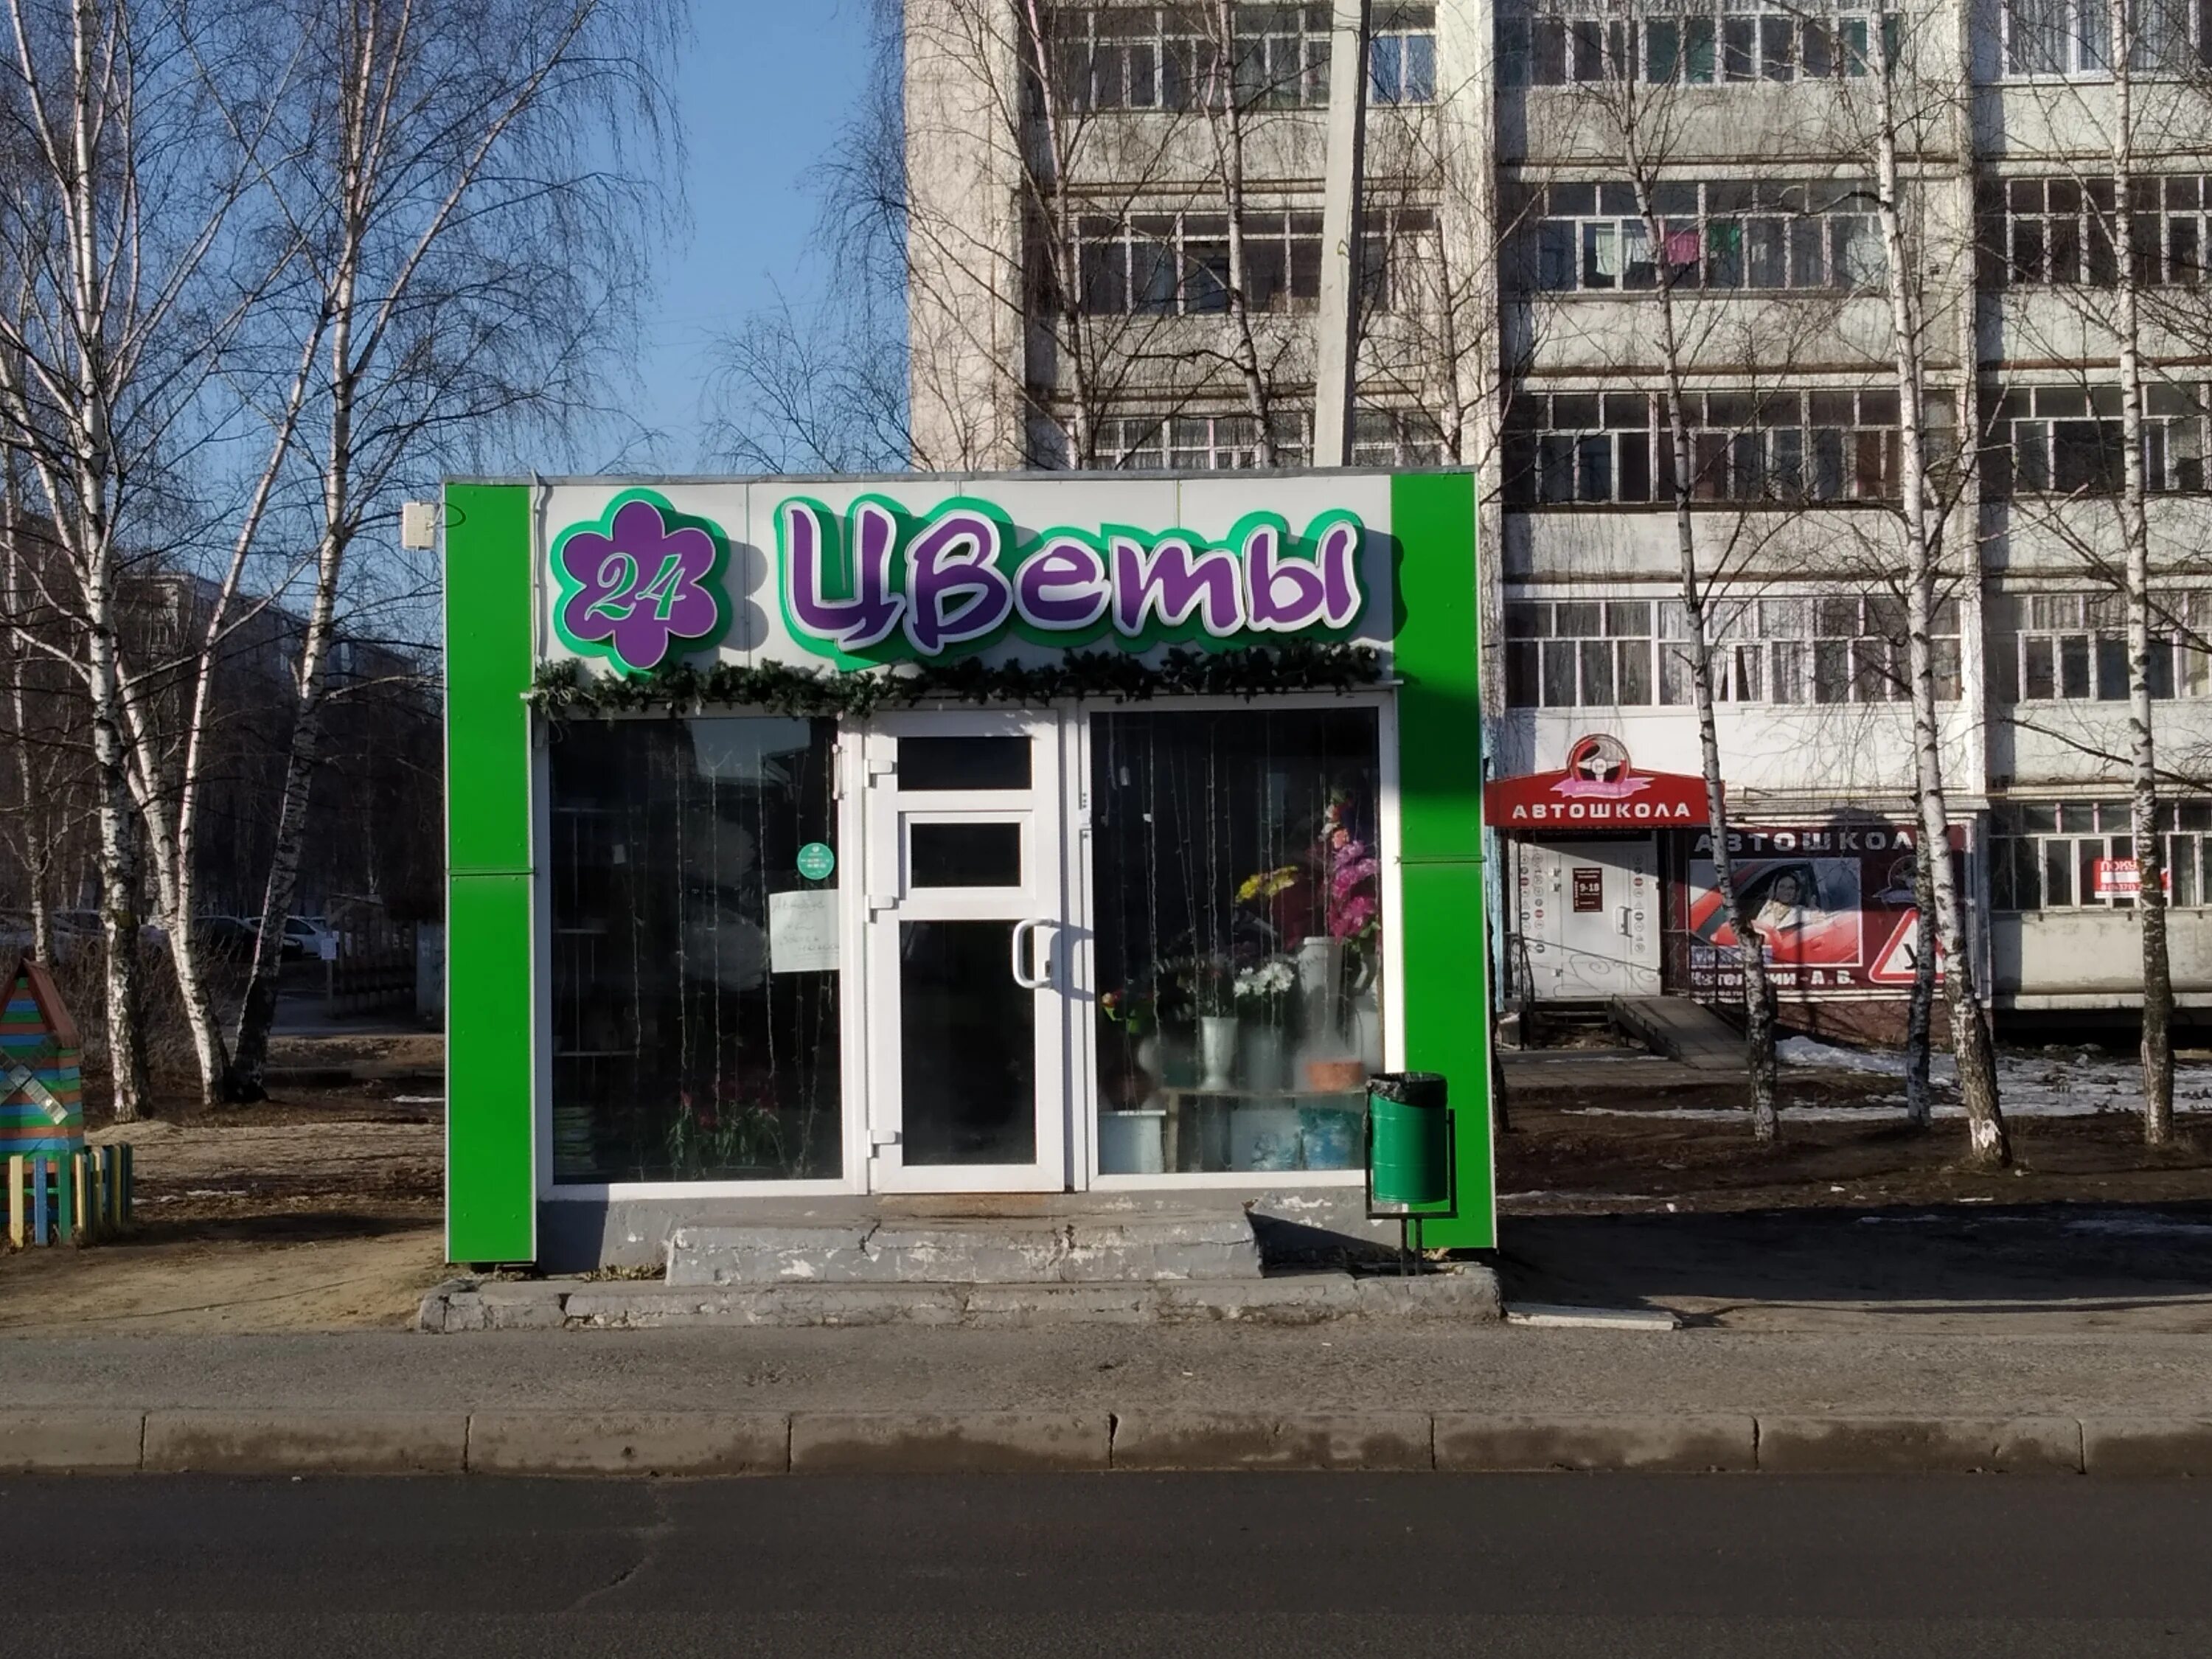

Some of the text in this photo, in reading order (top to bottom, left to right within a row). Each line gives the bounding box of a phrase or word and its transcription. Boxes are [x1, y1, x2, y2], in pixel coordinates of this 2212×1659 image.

[584, 552, 686, 621] 24
[1512, 803, 1691, 819] АВТОШКОЛА
[1694, 830, 1913, 852] АВТОШКОЛ
